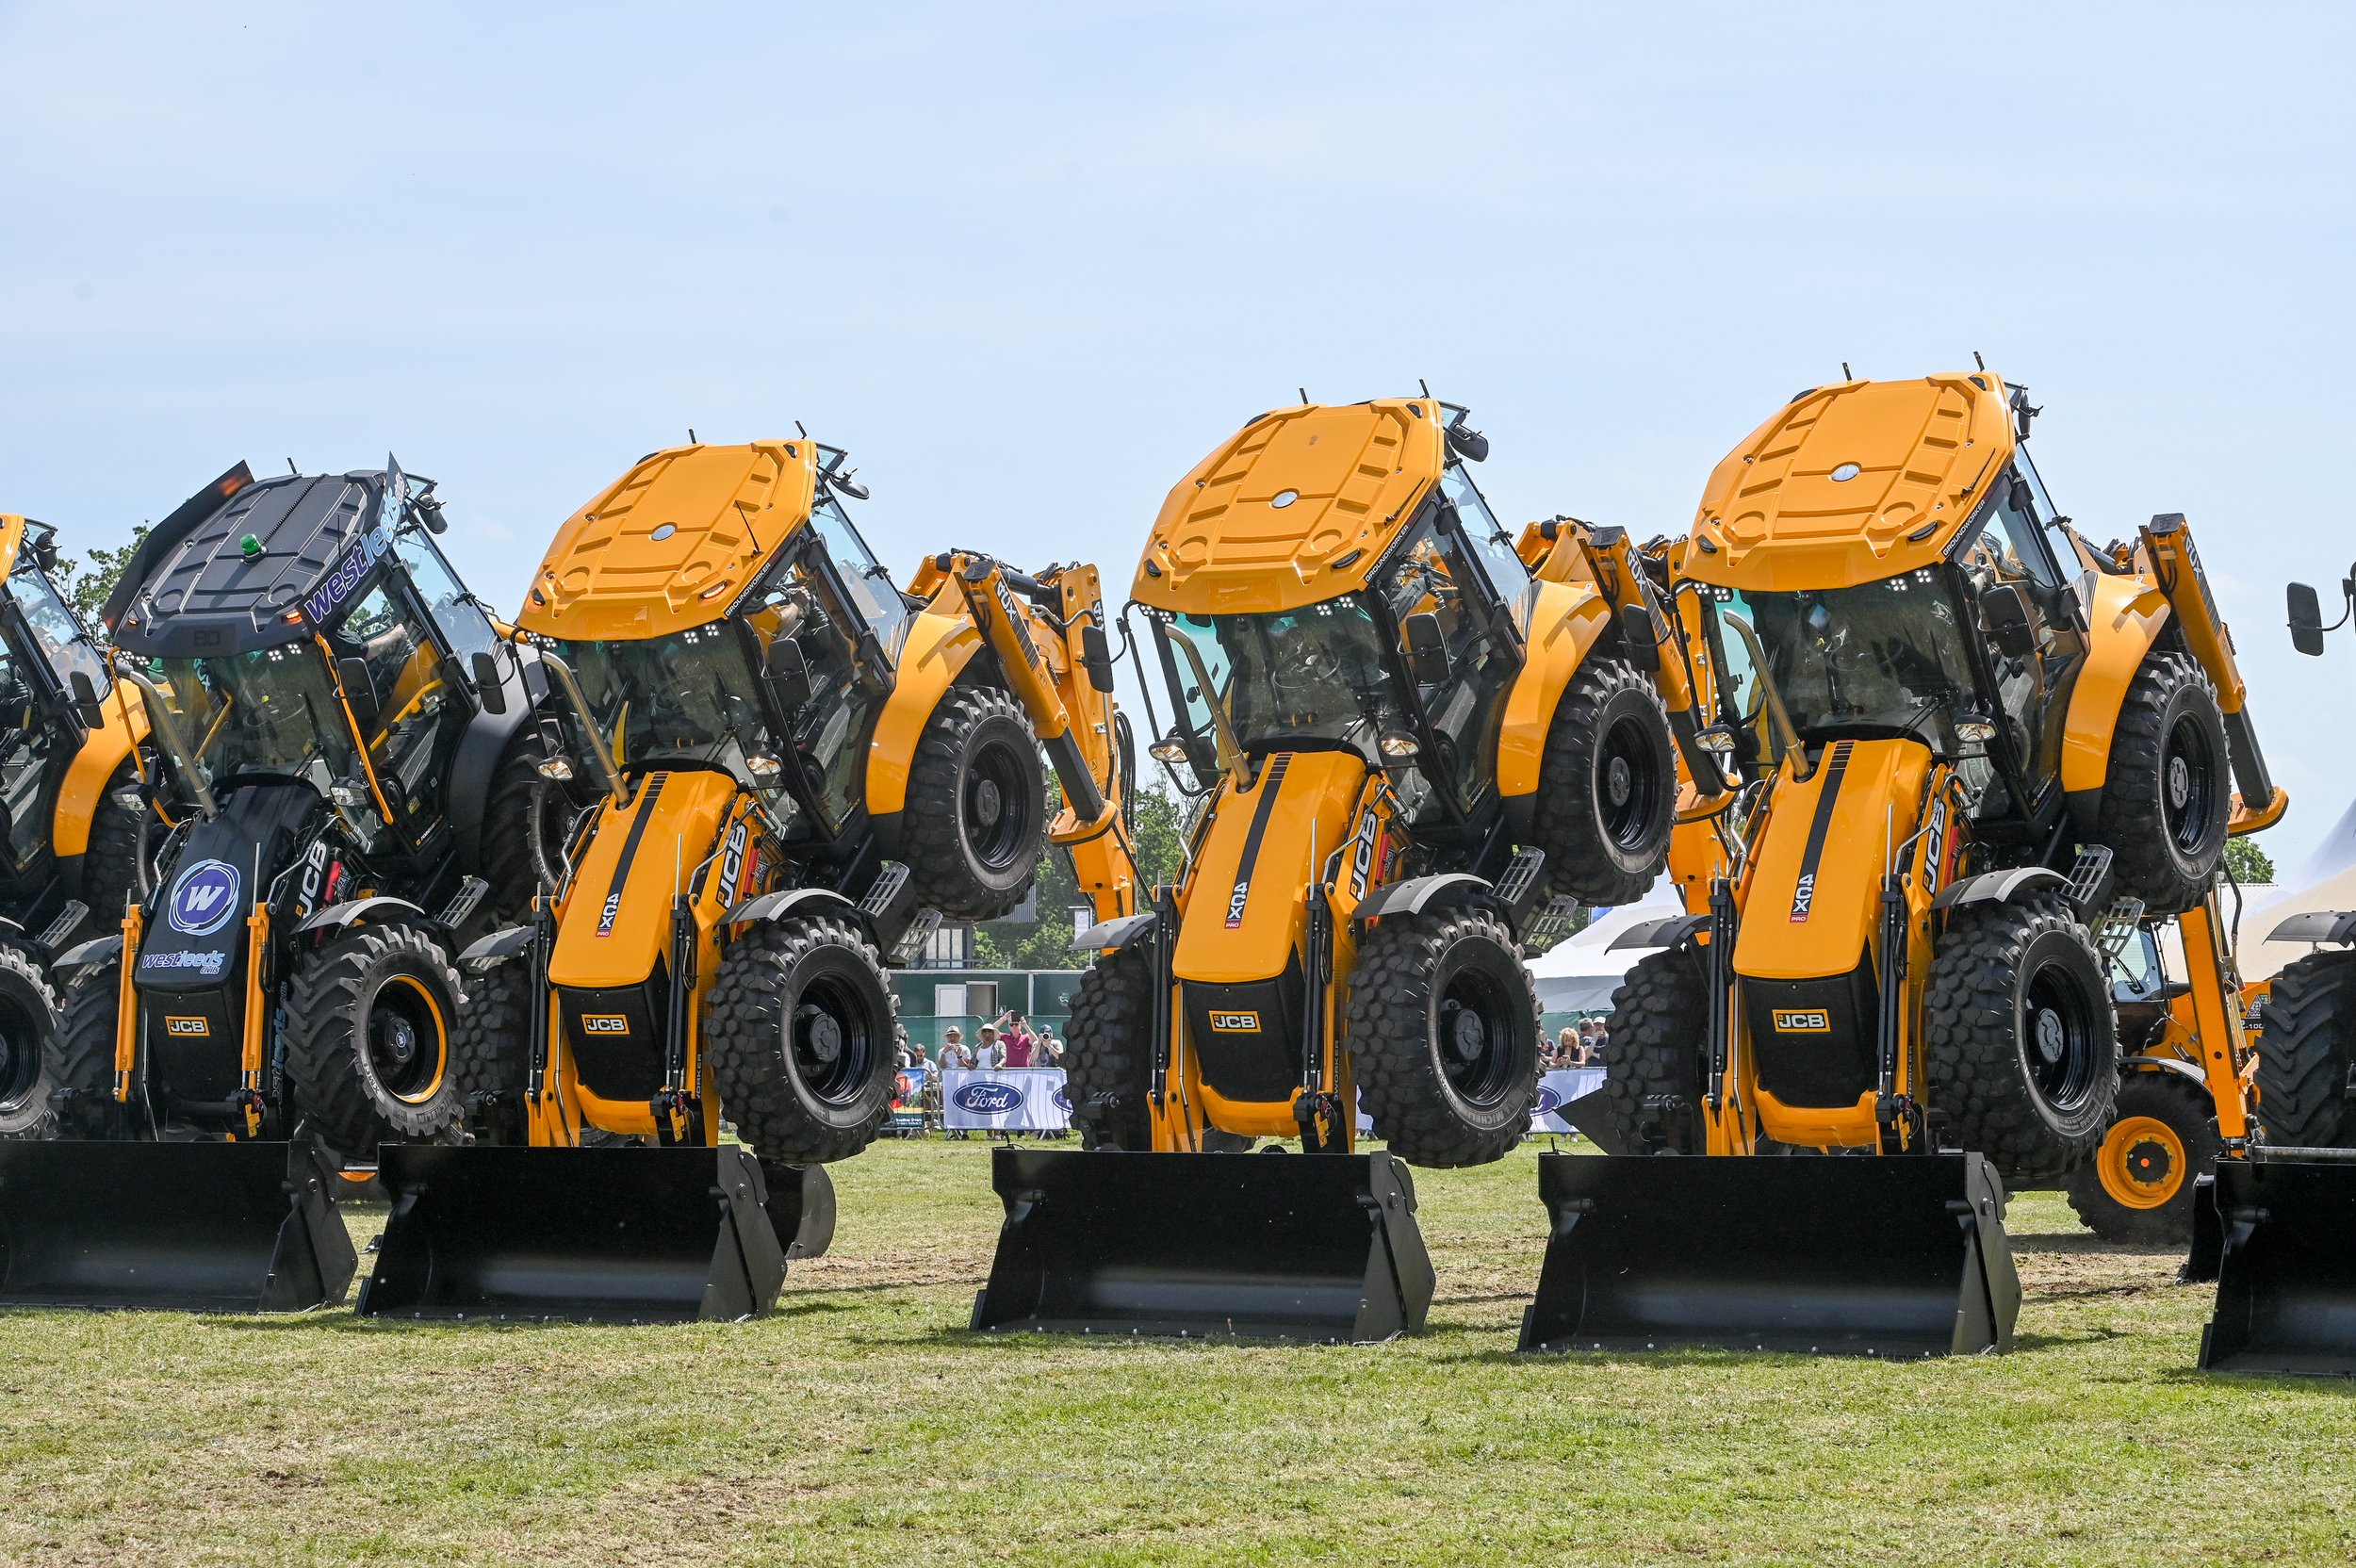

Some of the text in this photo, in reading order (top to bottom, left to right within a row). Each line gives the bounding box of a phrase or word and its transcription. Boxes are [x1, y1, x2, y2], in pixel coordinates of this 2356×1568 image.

[1942, 499, 1986, 556] GROUNDWORKER
[1365, 525, 1409, 581] GROUNDWORKER
[1628, 549, 1647, 592] 4CX
[2185, 536, 2203, 581] 4CX
[725, 563, 771, 616] GROUNDWORKER
[997, 581, 1017, 622] 4CX
[719, 824, 747, 907] JCB
[1352, 810, 1378, 901] JCB
[1925, 797, 1947, 893] JCB
[185, 885, 225, 912] W
[300, 840, 328, 920] JCB
[1227, 881, 1248, 919] 4CX
[1792, 874, 1814, 912] 4CX
[598, 892, 620, 928] 4CX
[171, 1021, 205, 1032] JCB
[587, 1019, 625, 1031] JCB
[1215, 1016, 1256, 1028] JCB
[1778, 1014, 1825, 1028] JCB
[966, 1086, 1008, 1108] Ford
